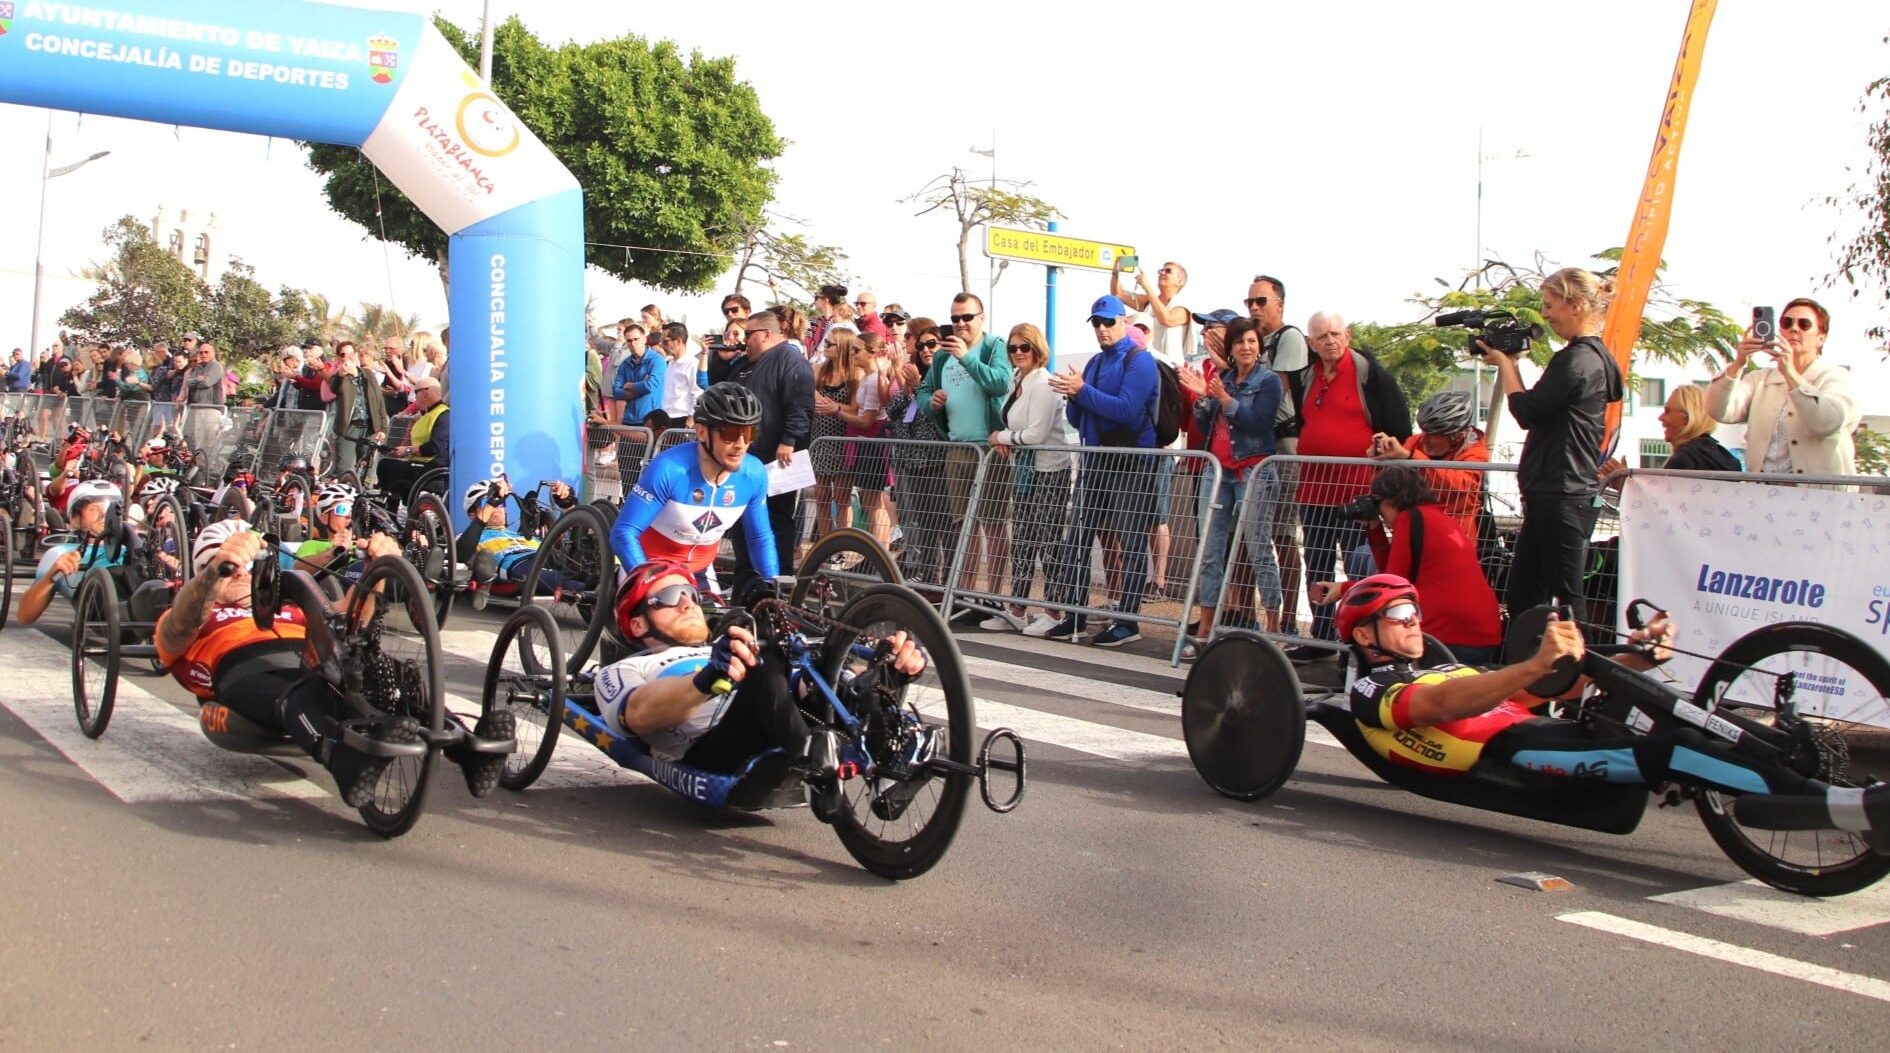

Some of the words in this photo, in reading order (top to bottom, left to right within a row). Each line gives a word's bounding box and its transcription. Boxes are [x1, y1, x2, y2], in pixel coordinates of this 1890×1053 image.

[24, 1, 240, 47] AYUNTAMIENTO
[247, 30, 281, 53] DE
[287, 35, 362, 62] YAIZA
[25, 32, 183, 71] CONCEJALÍA
[189, 55, 222, 75] DE
[227, 59, 350, 90] DEPORTES
[414, 107, 495, 194] PLAYABLANCA
[993, 233, 1019, 250] Casa
[1023, 238, 1039, 252] del
[1043, 240, 1095, 260] Embajador
[490, 254, 508, 383] CONCEJALÍA
[490, 389, 505, 415] DE
[490, 423, 506, 483] DEPO
[1693, 601, 1701, 611] A
[1706, 603, 1760, 621] UNIQUE
[1697, 564, 1825, 608] Lanzarote
[1819, 674, 1838, 684] spirit
